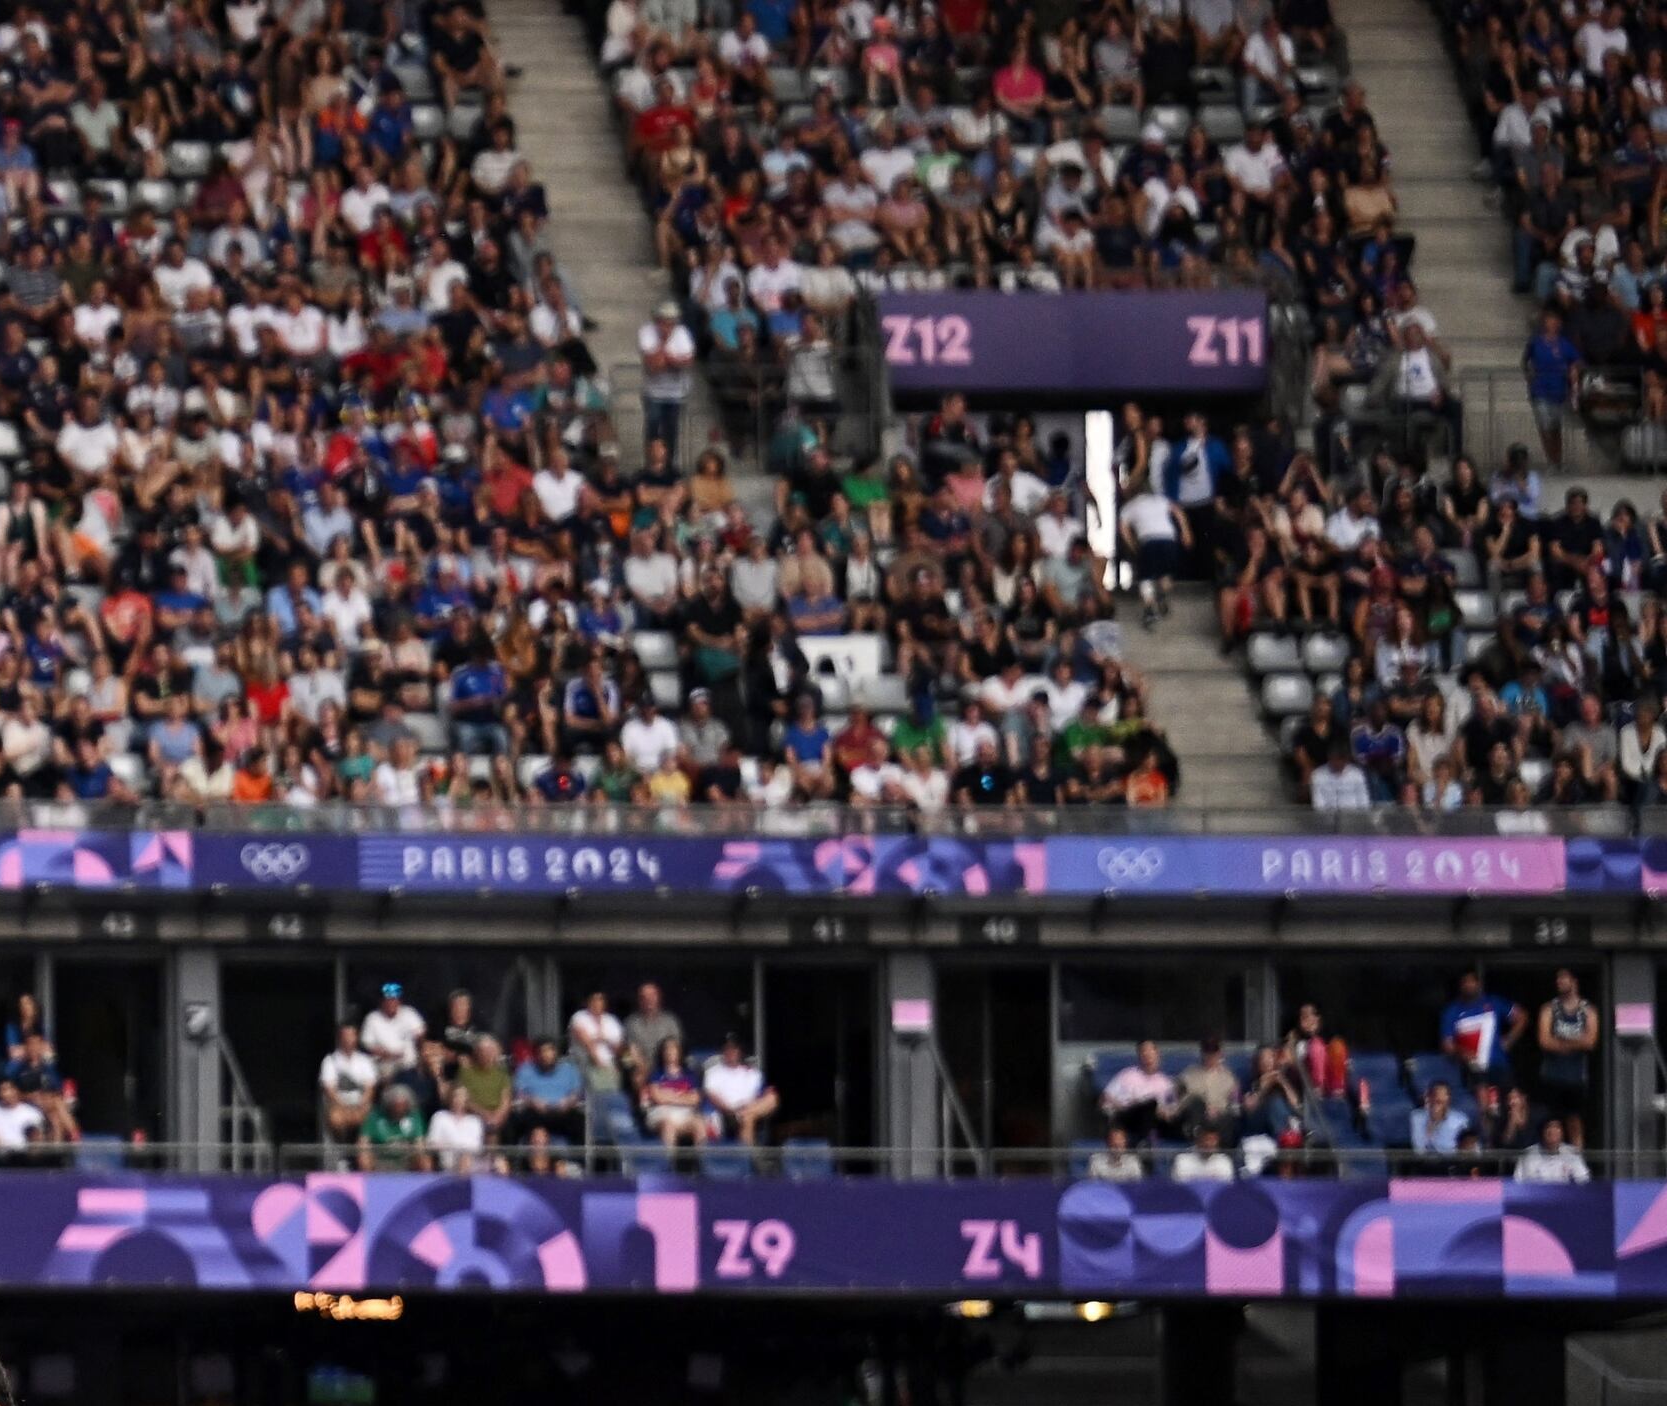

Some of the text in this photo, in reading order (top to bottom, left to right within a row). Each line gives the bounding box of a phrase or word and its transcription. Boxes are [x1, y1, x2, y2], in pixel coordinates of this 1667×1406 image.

[882, 314, 973, 366] Z12
[1186, 316, 1262, 366] Z11
[403, 845, 661, 883] PARIS 2024
[1262, 849, 1520, 884] PARIS 2024
[714, 1219, 795, 1278] Z9
[961, 1219, 1043, 1279] Z4
